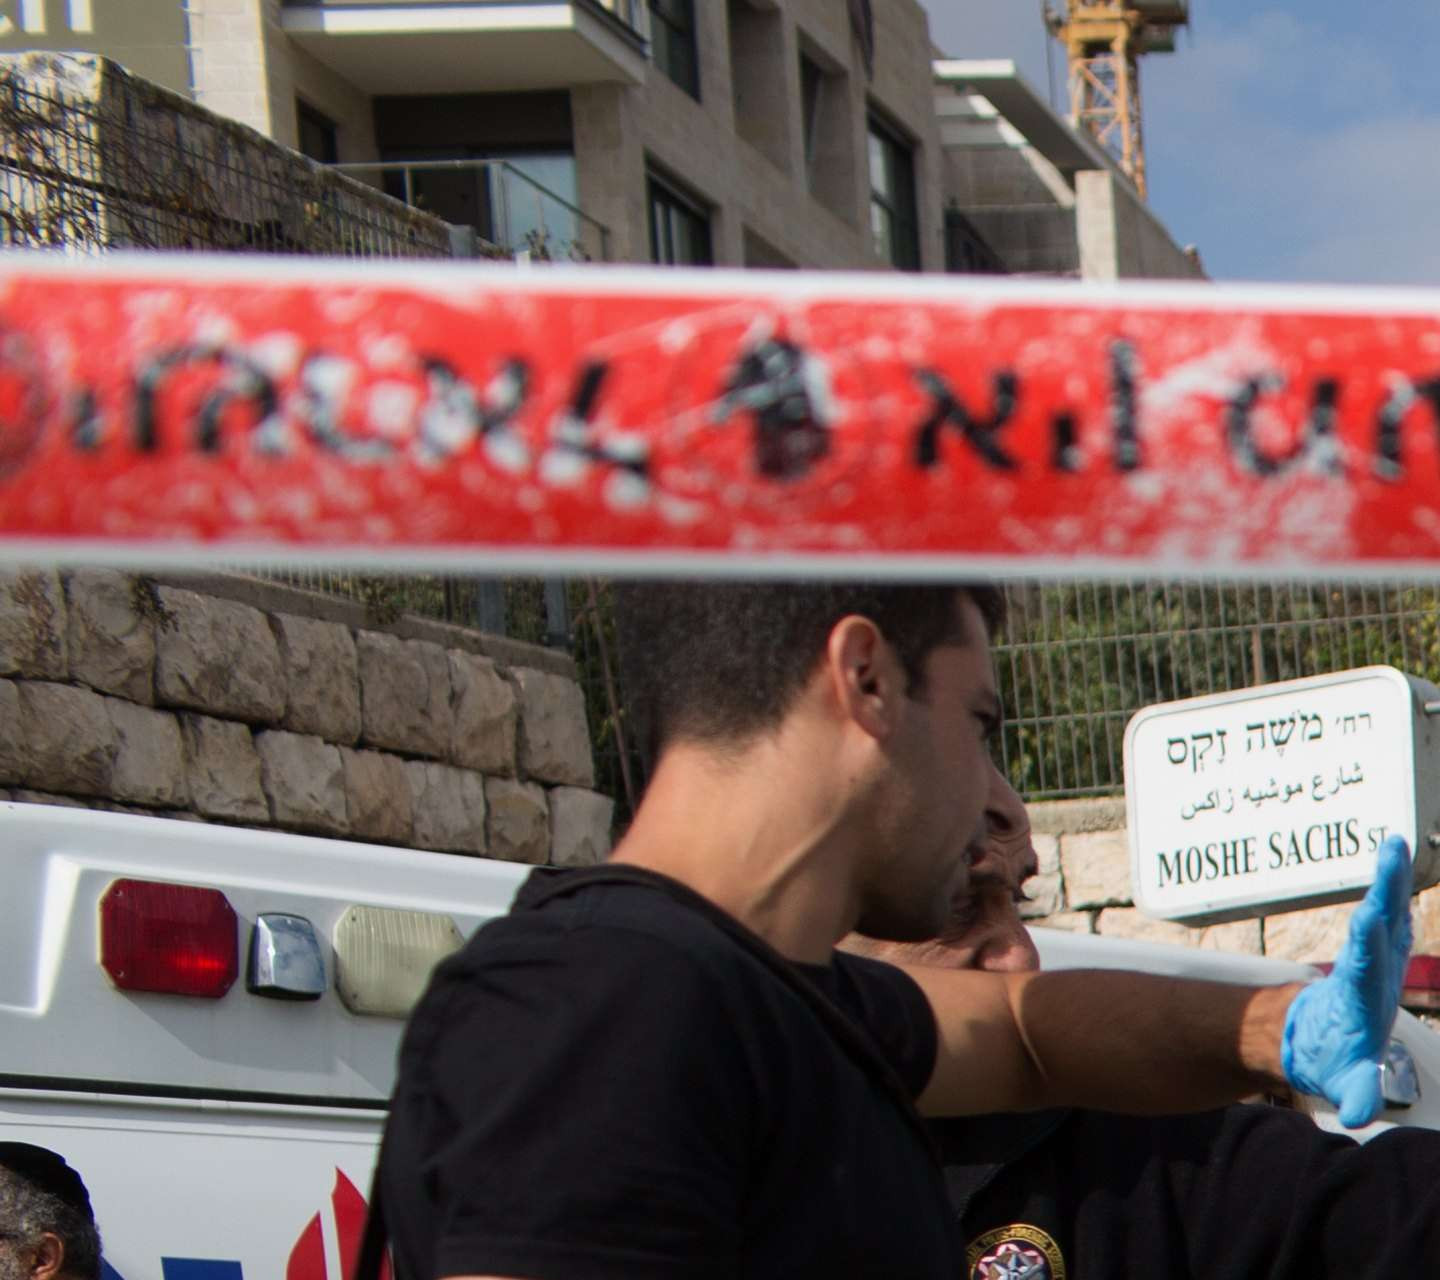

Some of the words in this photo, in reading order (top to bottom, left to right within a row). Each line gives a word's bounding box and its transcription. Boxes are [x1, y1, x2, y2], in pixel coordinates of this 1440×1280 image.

[1311, 762, 1364, 802] شارع
[1157, 836, 1258, 888] MOSHE
[1268, 818, 1360, 871] SACHS
